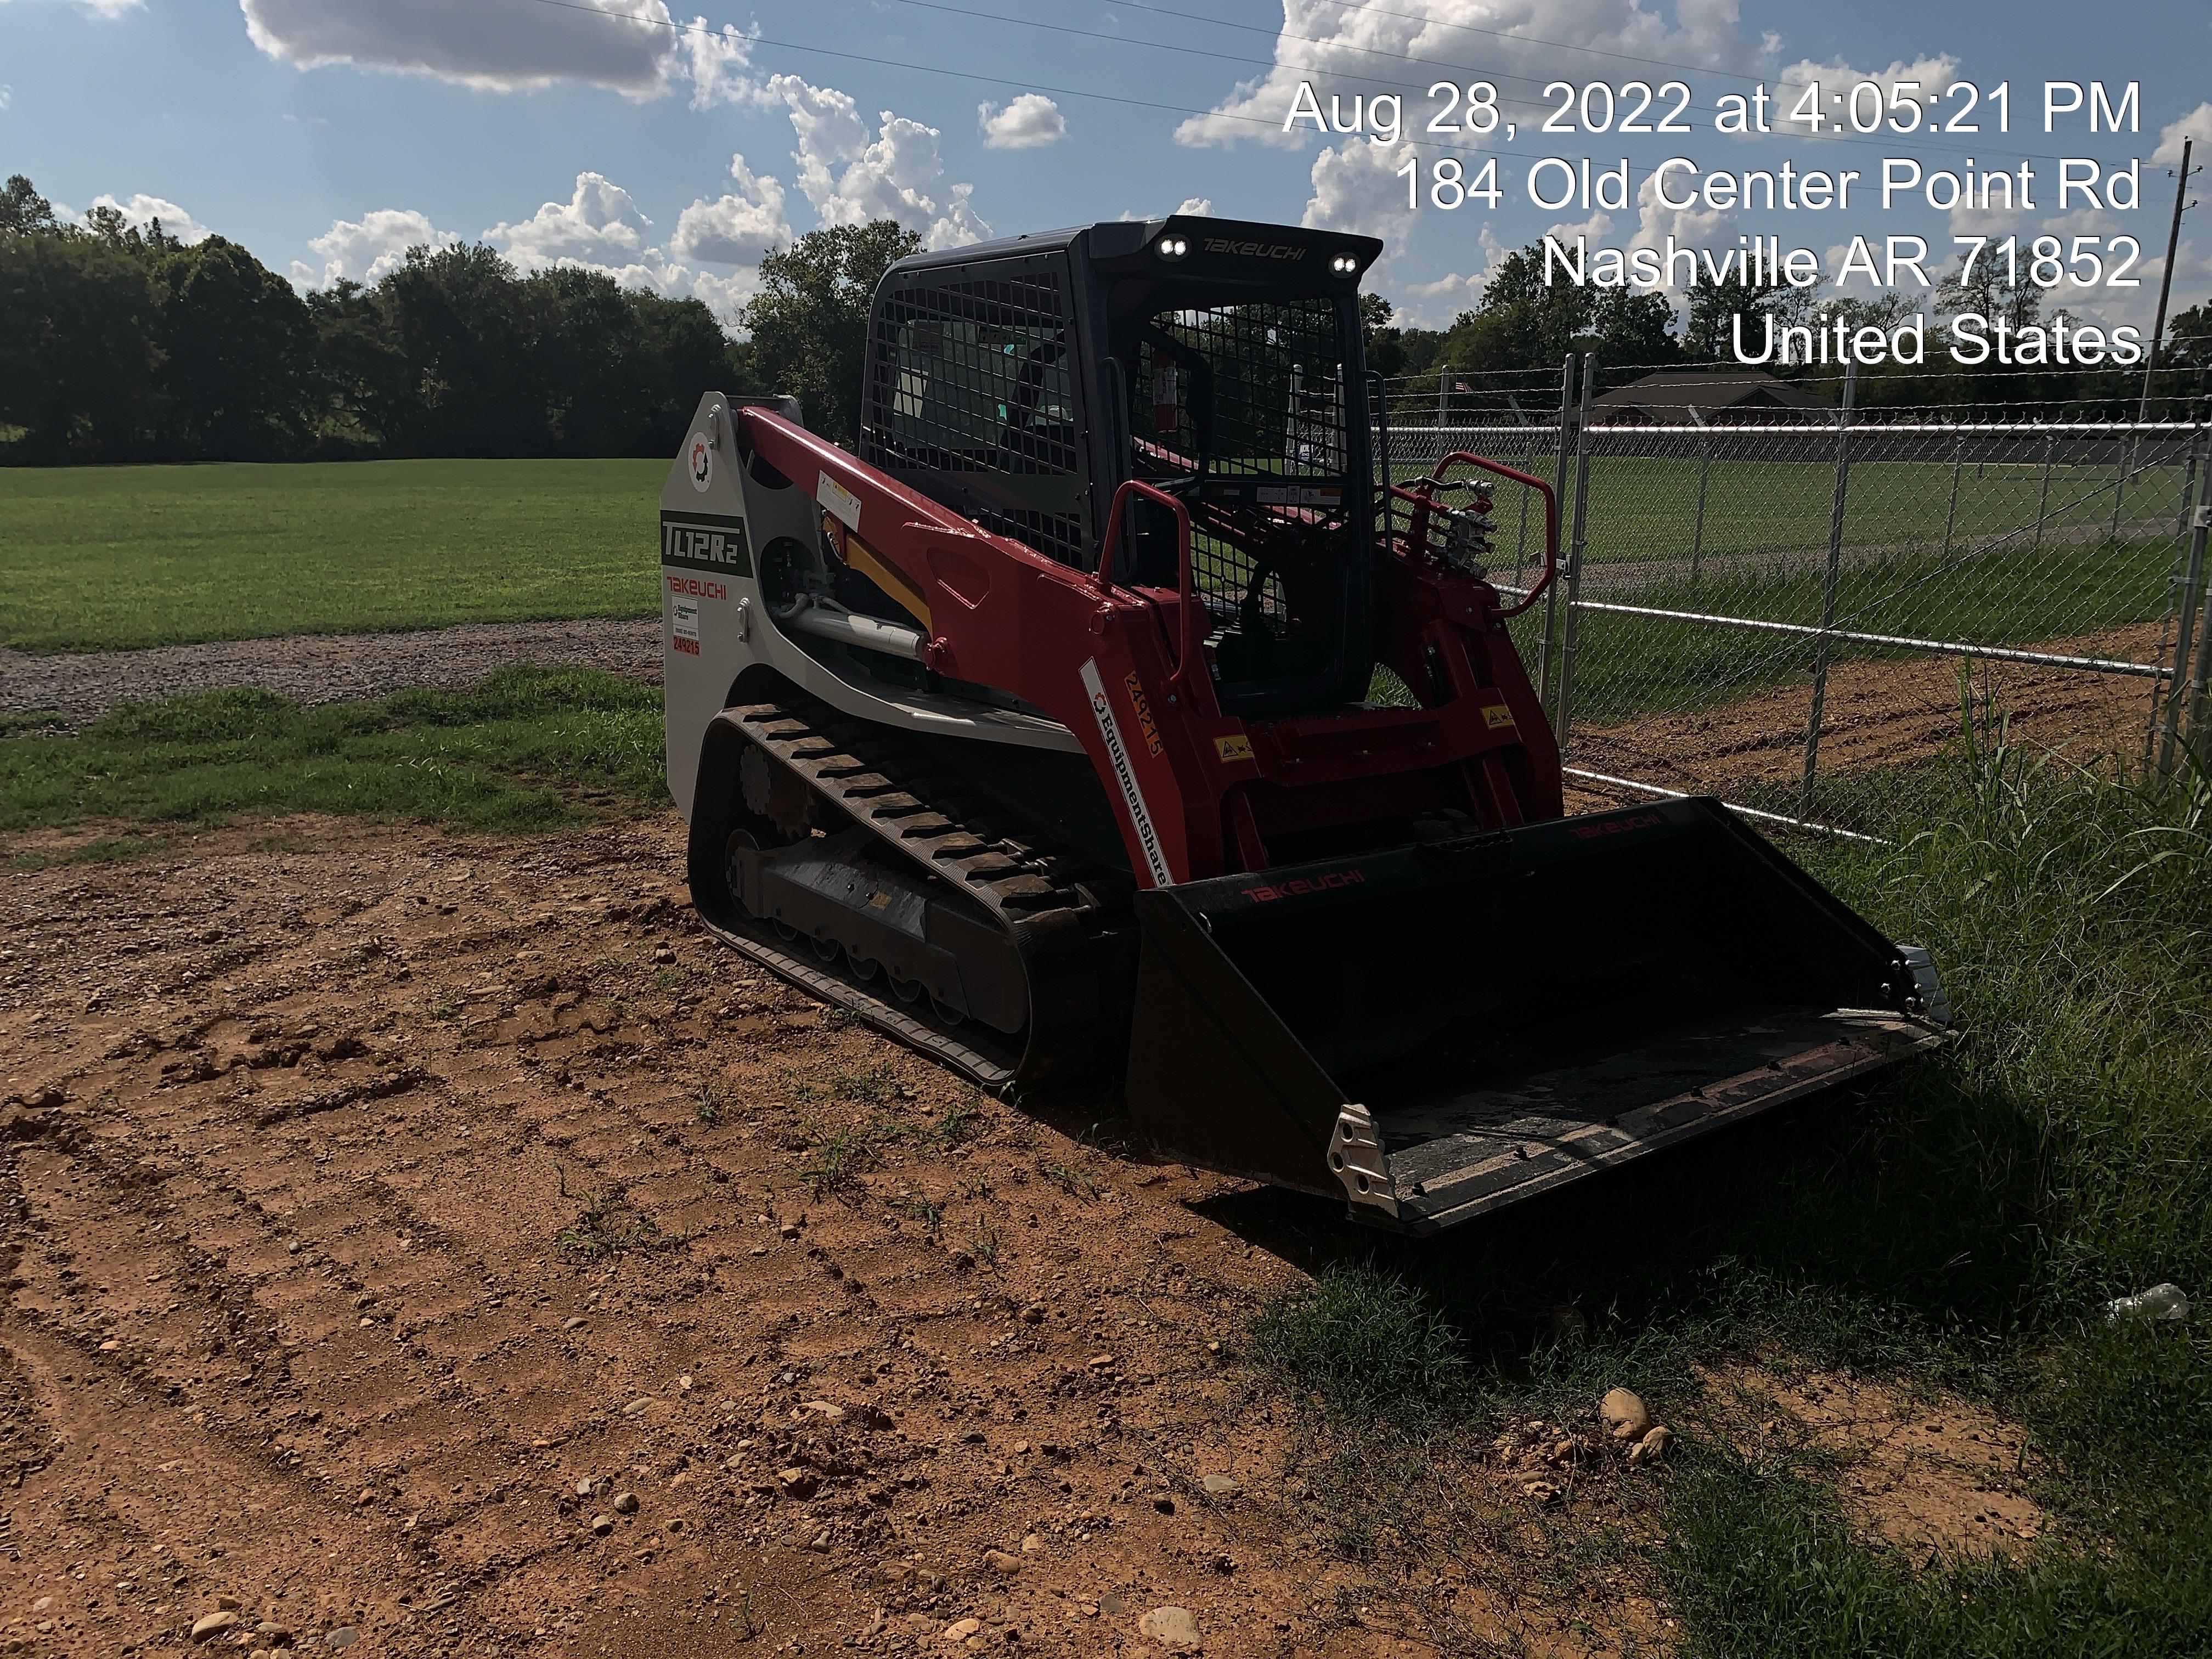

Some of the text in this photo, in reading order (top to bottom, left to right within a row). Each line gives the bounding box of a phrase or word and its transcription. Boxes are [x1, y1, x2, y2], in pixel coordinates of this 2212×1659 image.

[662, 521, 740, 565] TL12R2
[673, 636, 699, 655] 249215
[1126, 674, 1162, 755] 249215
[1101, 714, 1166, 885] EquipmentShare
